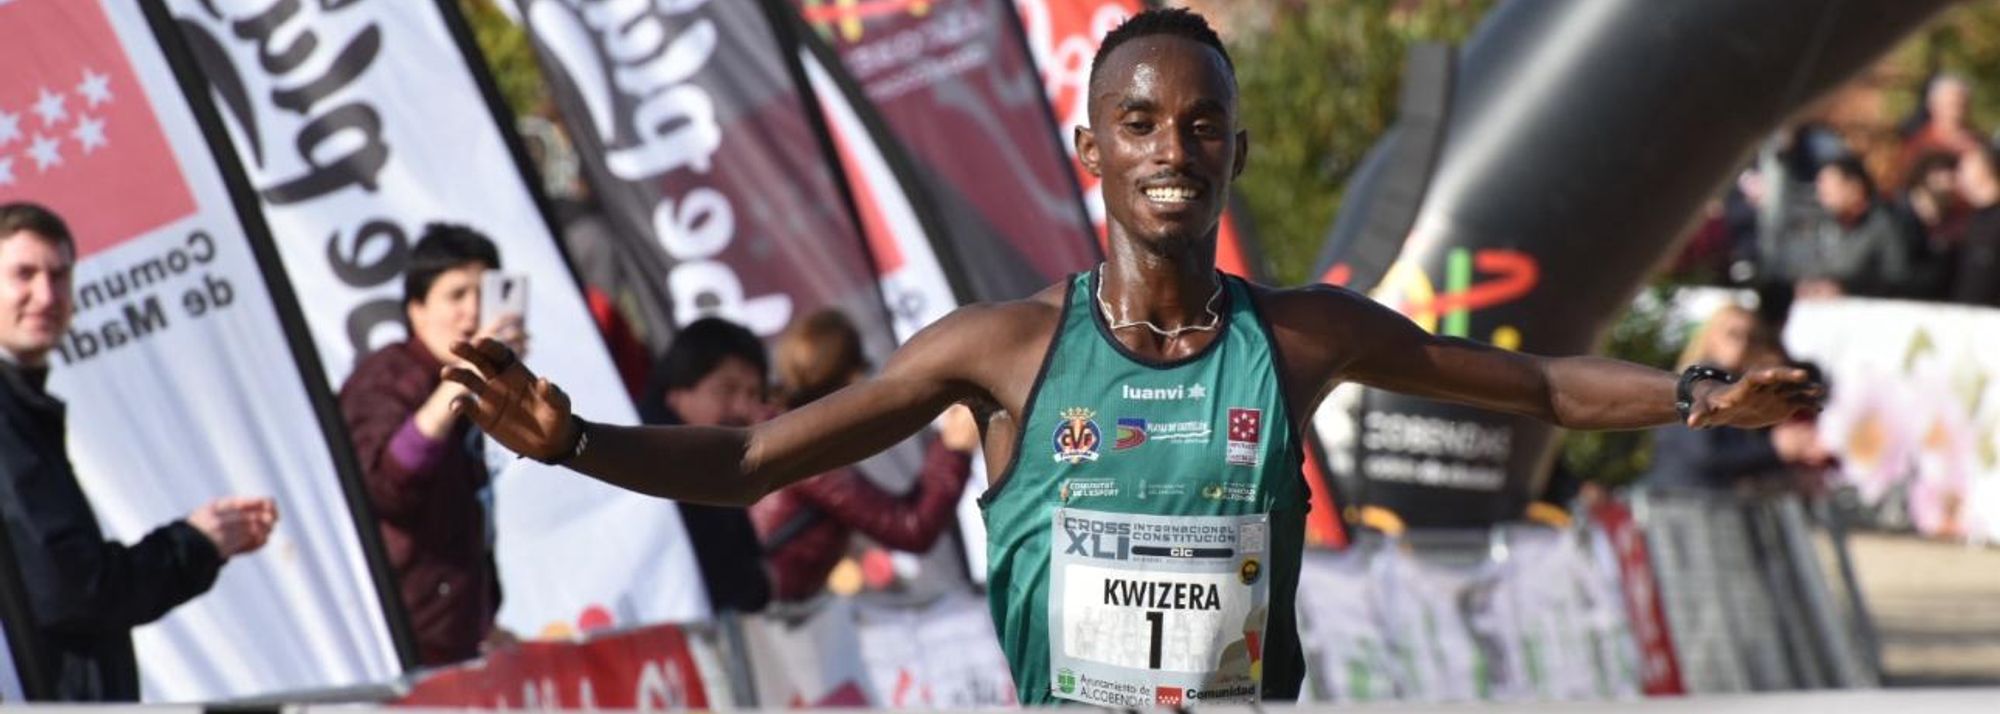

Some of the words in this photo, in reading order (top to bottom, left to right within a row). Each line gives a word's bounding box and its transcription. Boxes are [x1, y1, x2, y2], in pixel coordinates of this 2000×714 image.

[1122, 384, 1184, 400] luanvi
[1064, 517, 1131, 535] CROSS
[1133, 523, 1235, 535] INTERNACIONAL
[1064, 529, 1130, 561] XLI
[1103, 577, 1222, 611] KWIZERA
[1146, 611, 1164, 670] 1
[1080, 673, 1138, 694] Ayuntamiento
[1139, 684, 1151, 697] de
[1186, 684, 1256, 700] Comunidad
